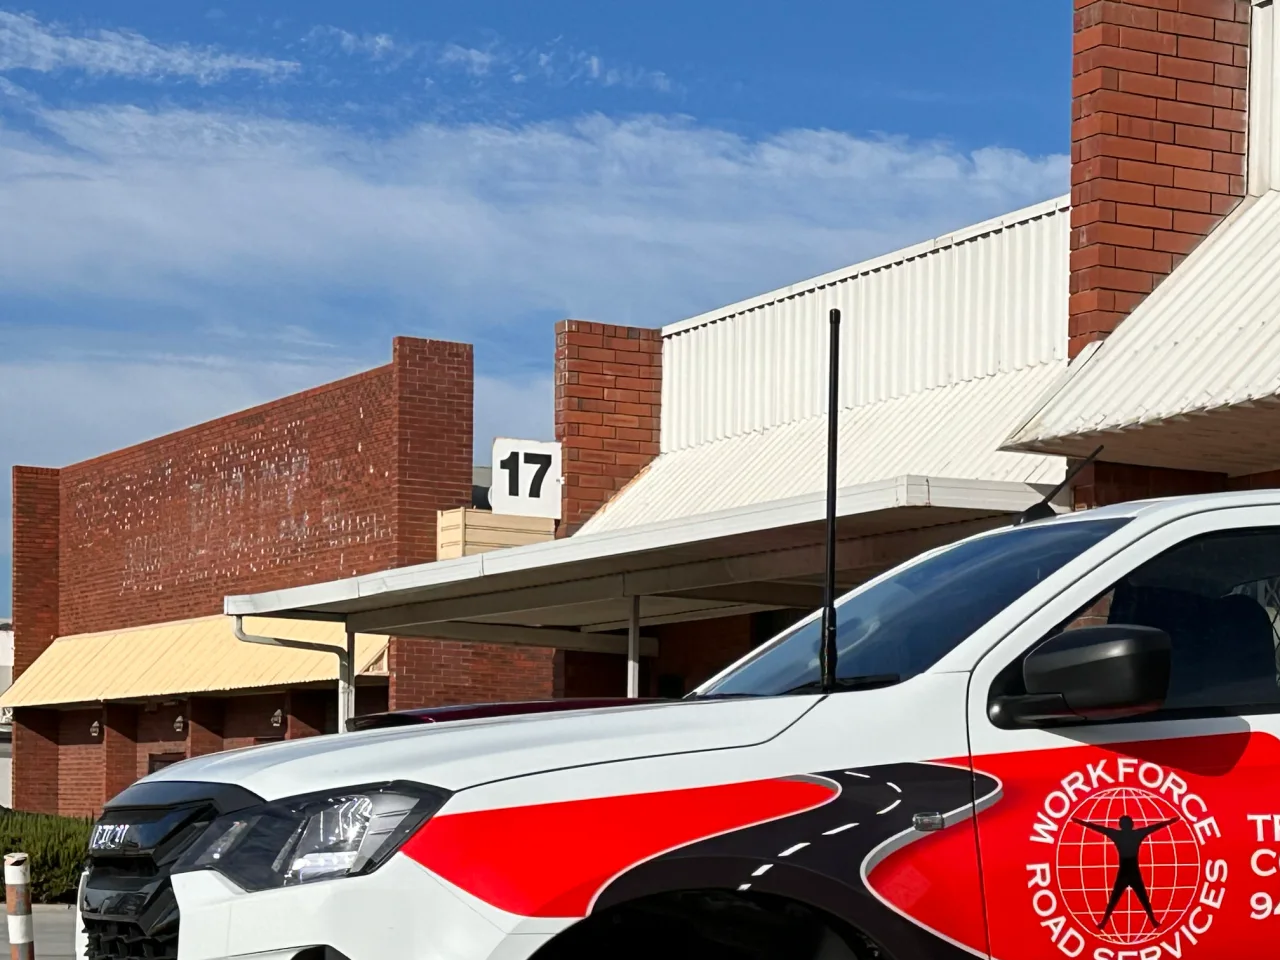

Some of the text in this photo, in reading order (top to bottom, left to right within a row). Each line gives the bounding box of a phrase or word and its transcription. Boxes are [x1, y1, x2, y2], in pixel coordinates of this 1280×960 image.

[500, 451, 552, 499] 17
[1031, 758, 1221, 845] WORKFORCE
[1026, 862, 1086, 959] ROAD
